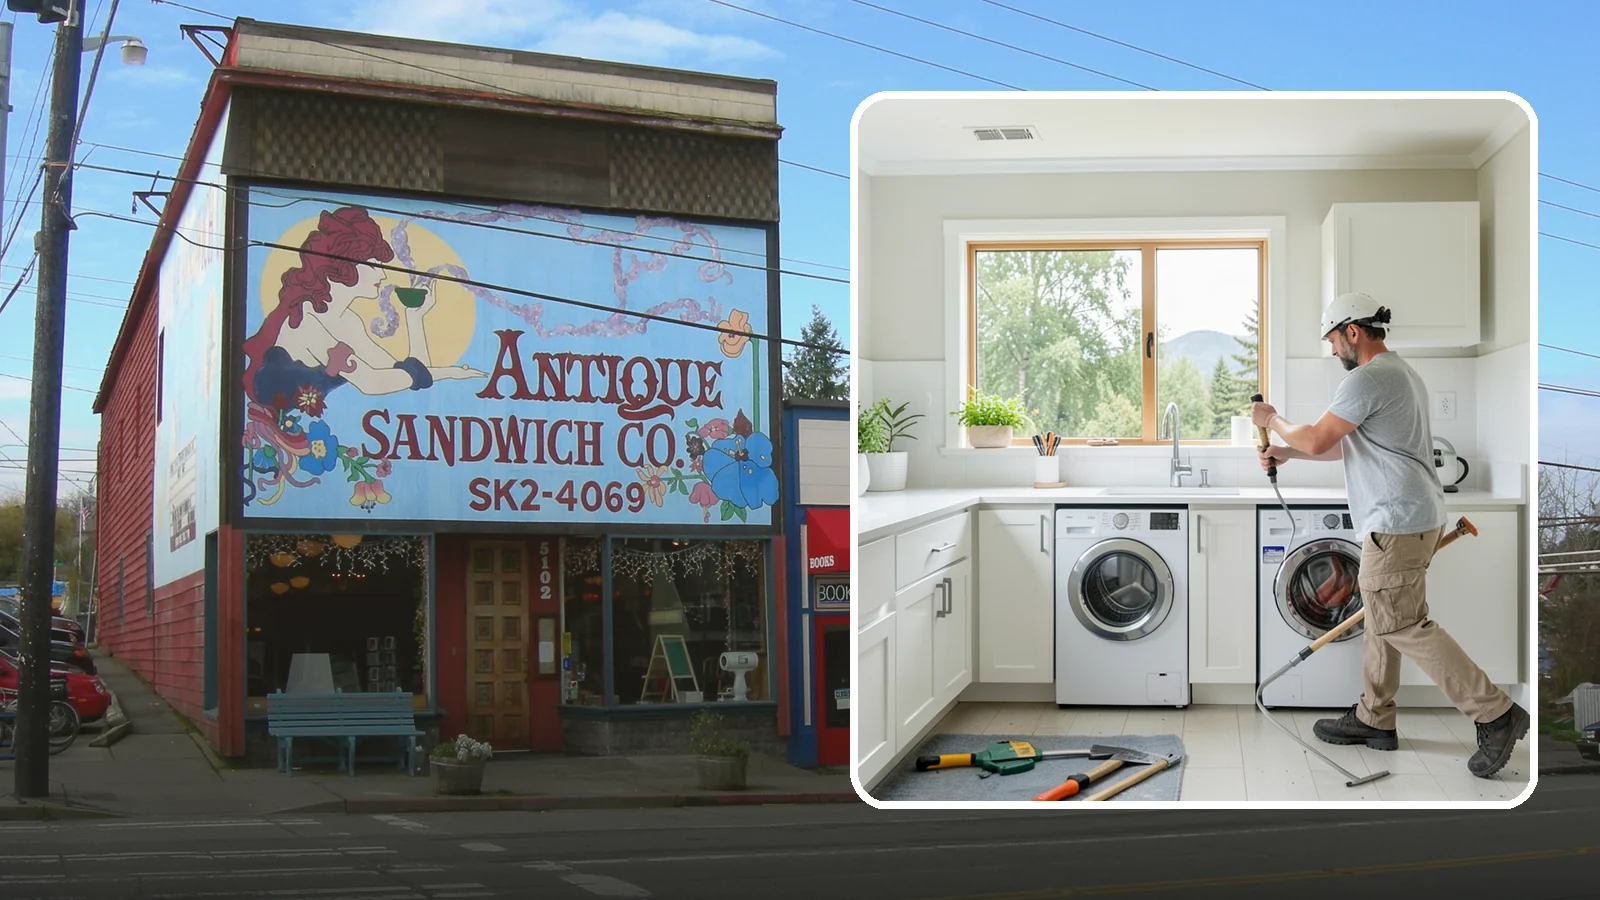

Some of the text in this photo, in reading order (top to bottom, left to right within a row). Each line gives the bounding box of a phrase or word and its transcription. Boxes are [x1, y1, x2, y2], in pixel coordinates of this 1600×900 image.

[475, 329, 724, 421] ANTIQUE
[361, 408, 685, 470] SANDWICH CO.
[468, 477, 646, 513] SK2-4069
[809, 555, 835, 569] BOOKS
